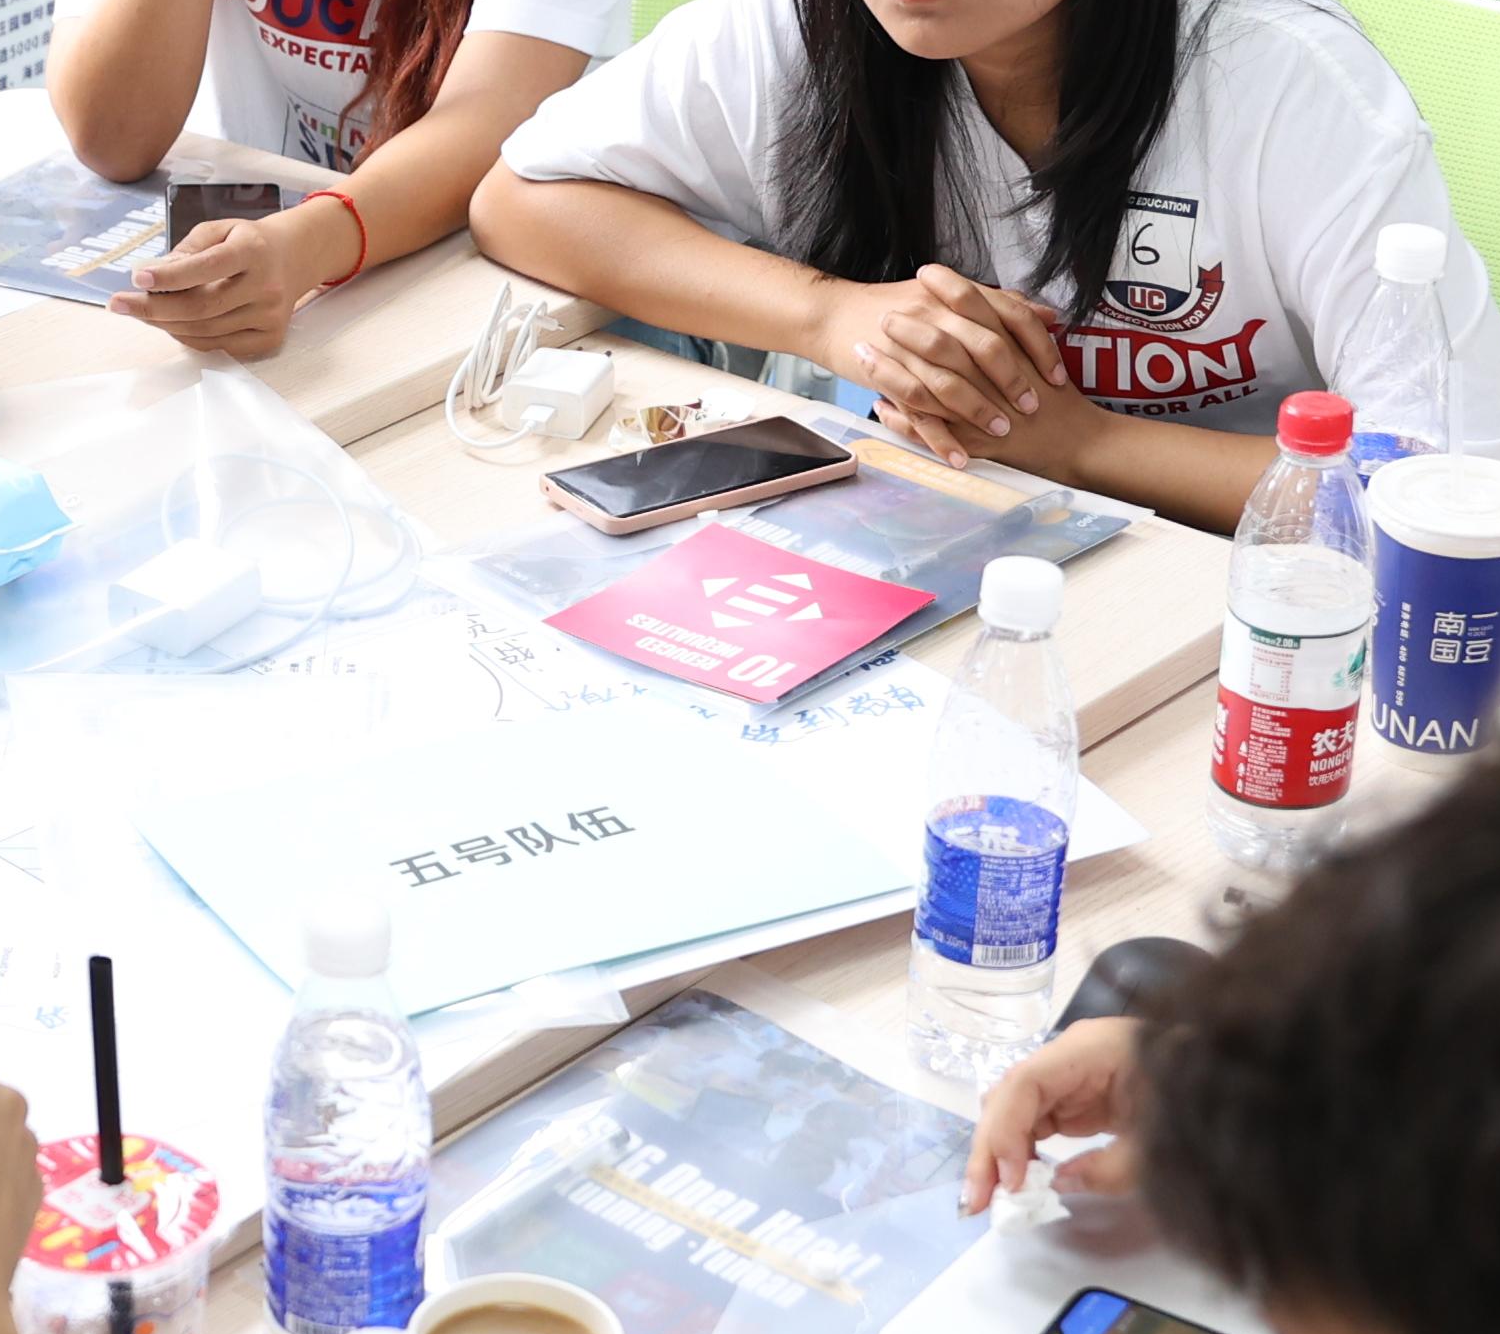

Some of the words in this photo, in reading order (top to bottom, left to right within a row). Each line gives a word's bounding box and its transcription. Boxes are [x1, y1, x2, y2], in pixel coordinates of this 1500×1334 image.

[259, 26, 371, 75] EXPECTA
[1136, 196, 1192, 213] EDUCATION
[1131, 222, 1160, 266] 6
[1127, 285, 1167, 312] UC
[1183, 309, 1206, 329] FOR
[1202, 290, 1218, 312] ALL
[1066, 333, 1244, 395] TION
[1123, 398, 1190, 417] FOR
[1199, 384, 1259, 410] ALL
[625, 613, 744, 659] INEQUALITIES
[635, 635, 723, 672] REDUCED
[728, 654, 797, 688] 10
[1373, 694, 1479, 750] UNAN
[388, 805, 637, 888] 五号队伍
